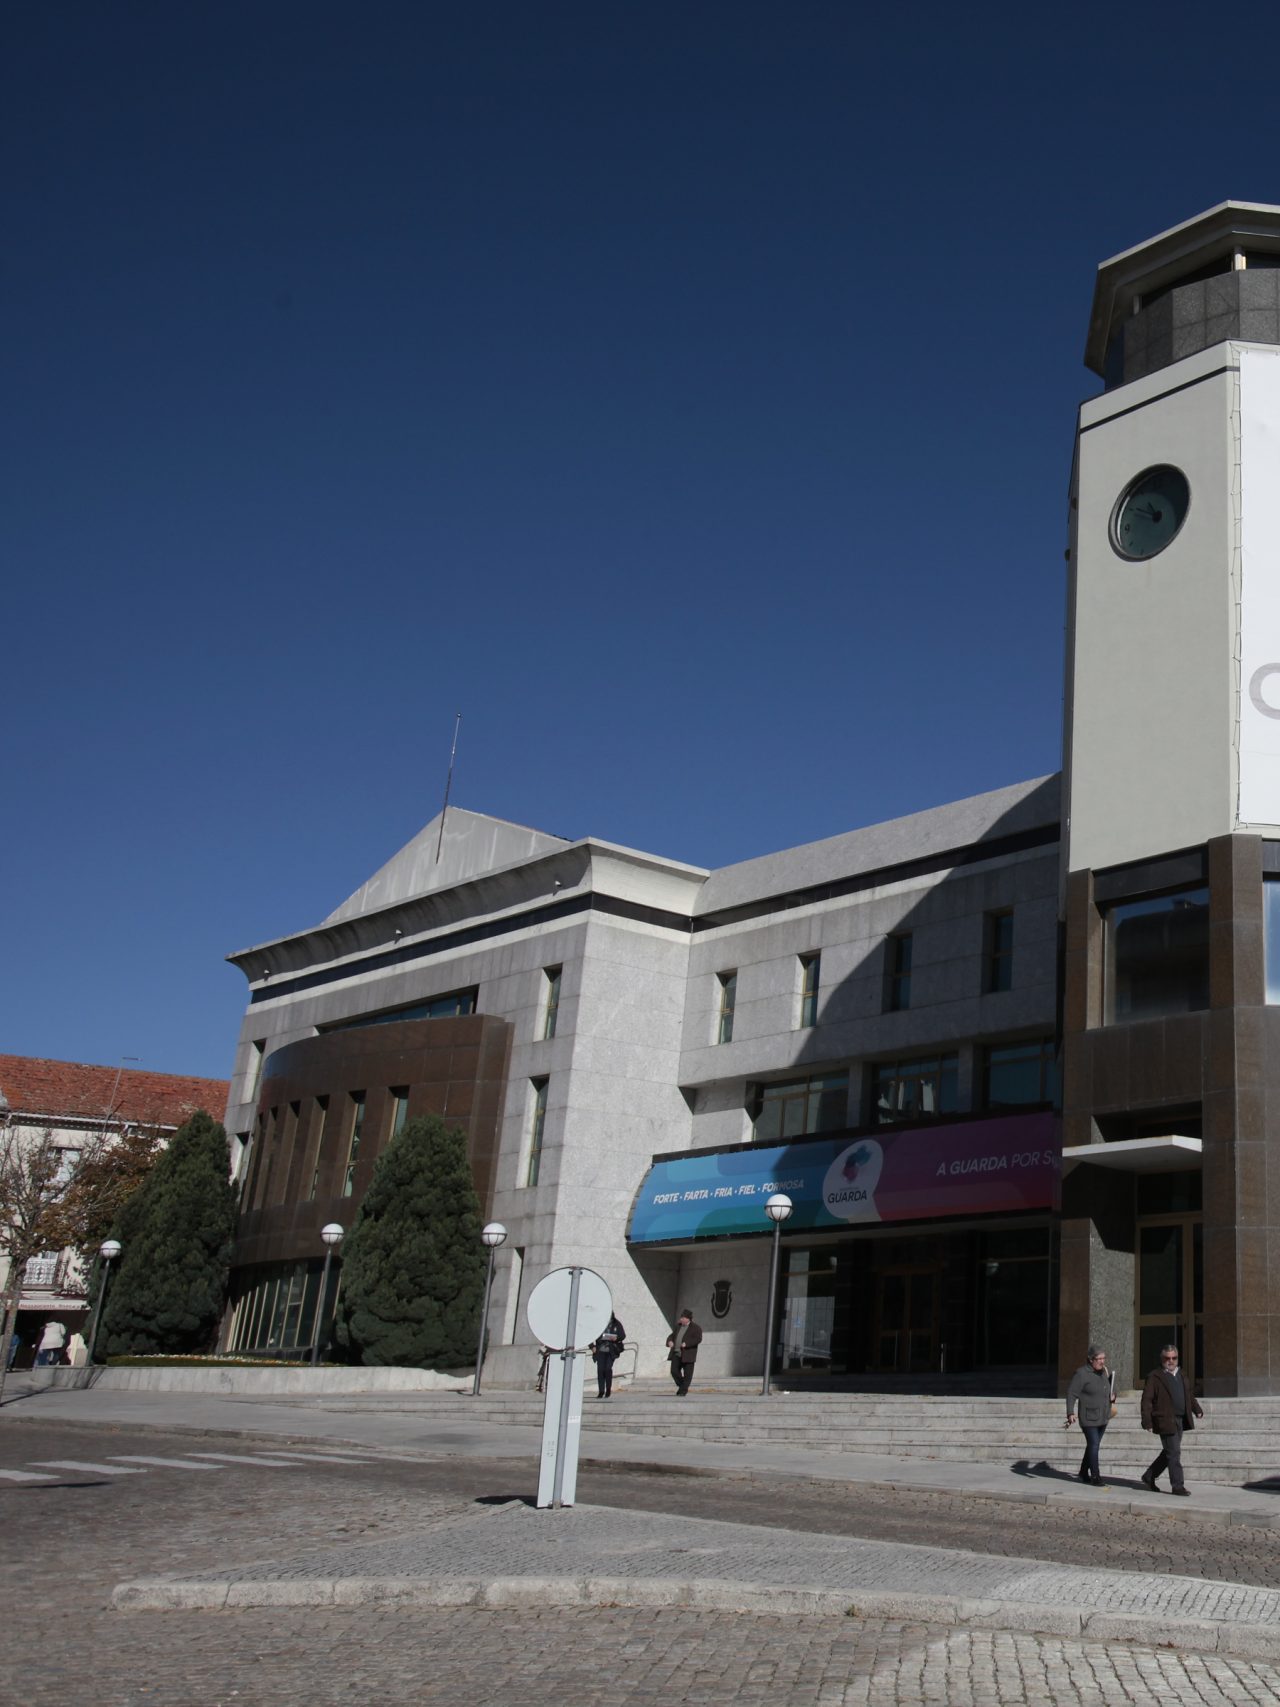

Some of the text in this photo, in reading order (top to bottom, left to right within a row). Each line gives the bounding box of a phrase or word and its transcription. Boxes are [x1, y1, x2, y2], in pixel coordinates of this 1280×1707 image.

[936, 1162, 946, 1176] A
[950, 1155, 1007, 1175] GUARDA
[1011, 1151, 1040, 1168] POR
[653, 1179, 804, 1204] FORTE FARTA FRIA FIEL FORMOSA
[828, 1190, 867, 1203] GUARDA
